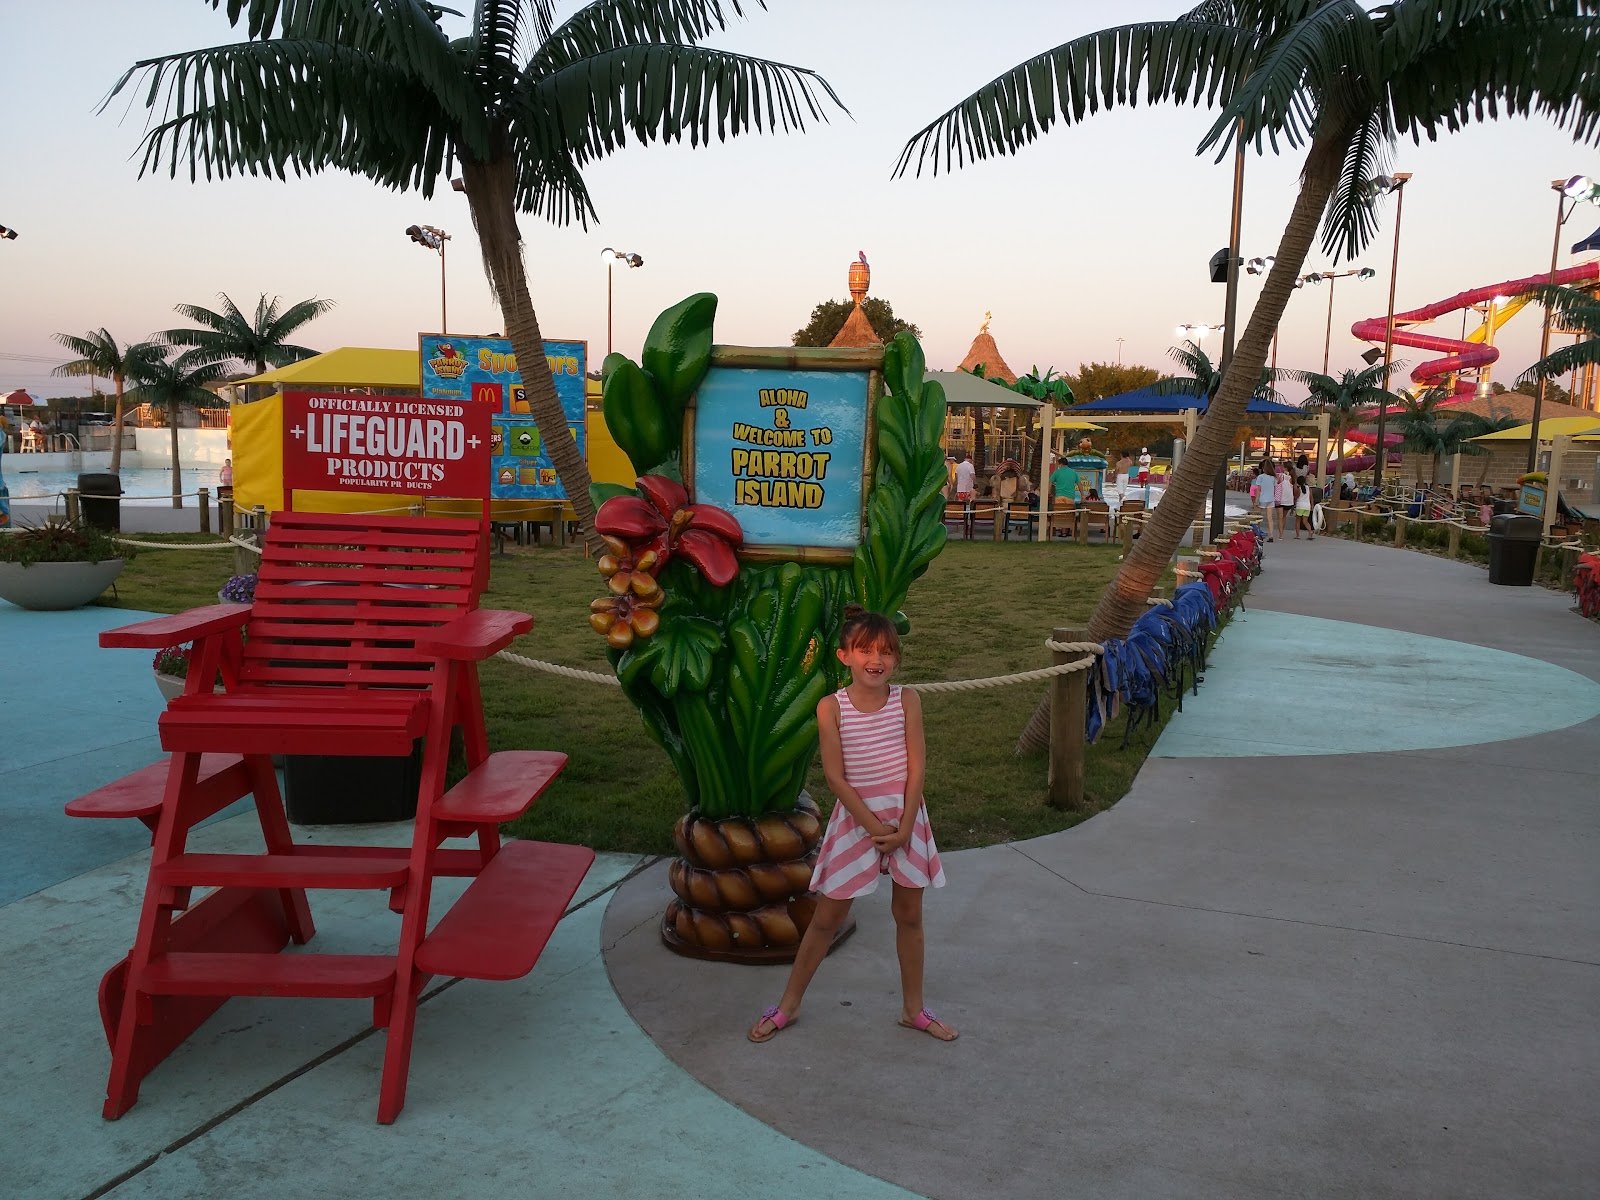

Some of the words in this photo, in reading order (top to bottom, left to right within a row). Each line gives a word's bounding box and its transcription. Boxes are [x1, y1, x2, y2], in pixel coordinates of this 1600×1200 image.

[478, 347, 578, 376] Spoors
[308, 397, 391, 413] OFFICIALLY
[395, 402, 464, 417] LICENSED
[759, 388, 808, 409] ALOHA
[774, 408, 791, 428] &
[306, 412, 465, 460] LIFEGUARD
[733, 422, 806, 448] WELCOME
[810, 427, 832, 446] TO
[326, 457, 445, 481] PRODUCTS
[732, 448, 831, 480] PARROT
[339, 477, 389, 488] POPULARITY
[390, 480, 433, 490] PRDUCTS
[735, 478, 825, 509] ISLAND
